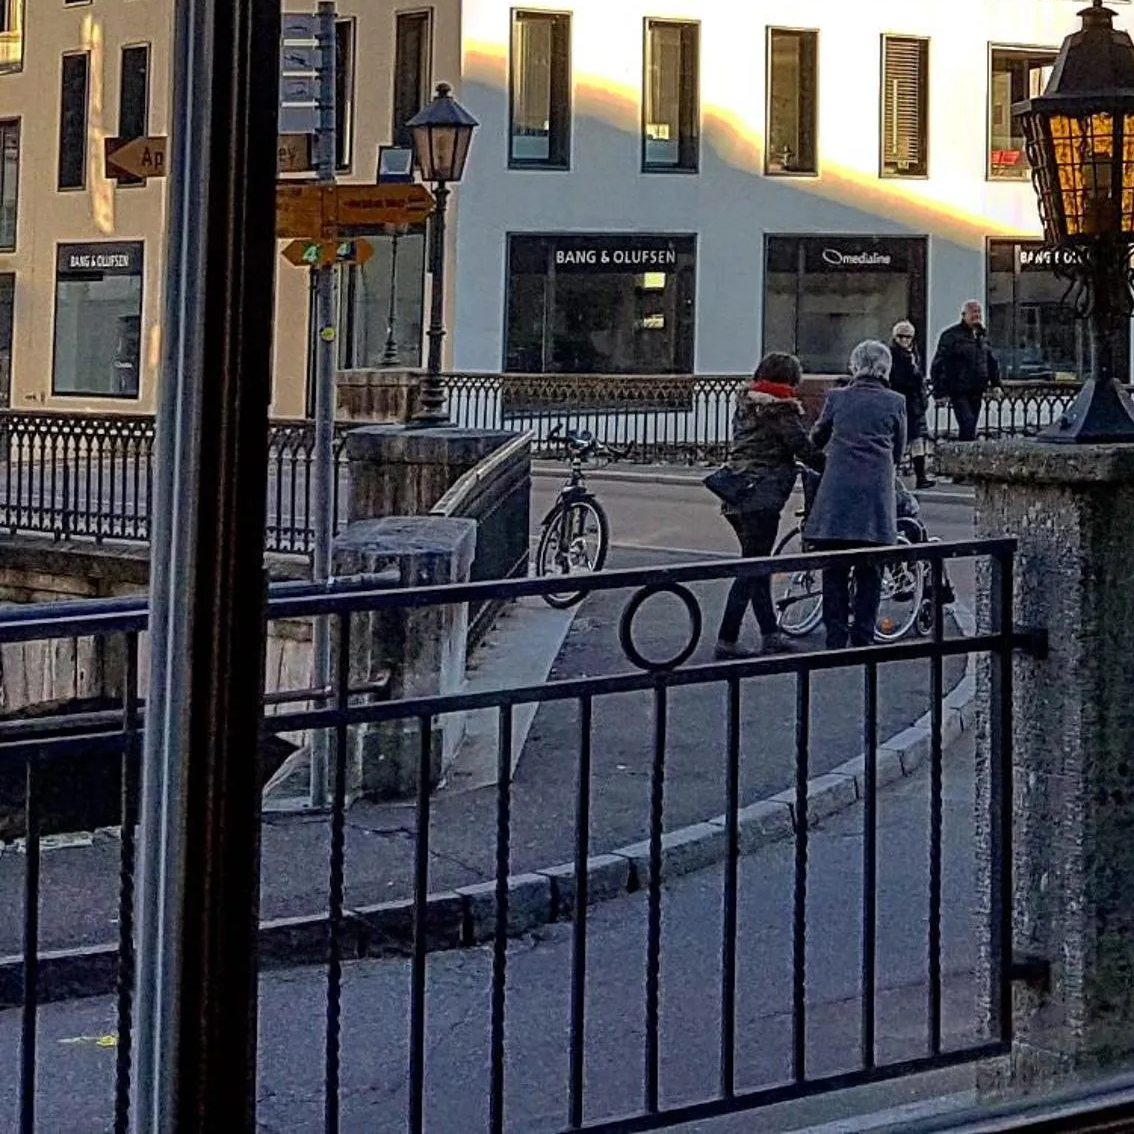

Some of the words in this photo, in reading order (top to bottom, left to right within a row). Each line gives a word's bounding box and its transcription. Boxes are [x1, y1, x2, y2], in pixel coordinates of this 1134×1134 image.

[556, 250, 597, 264] BANG
[601, 250, 610, 264] &
[613, 250, 676, 264] OLUFSEN
